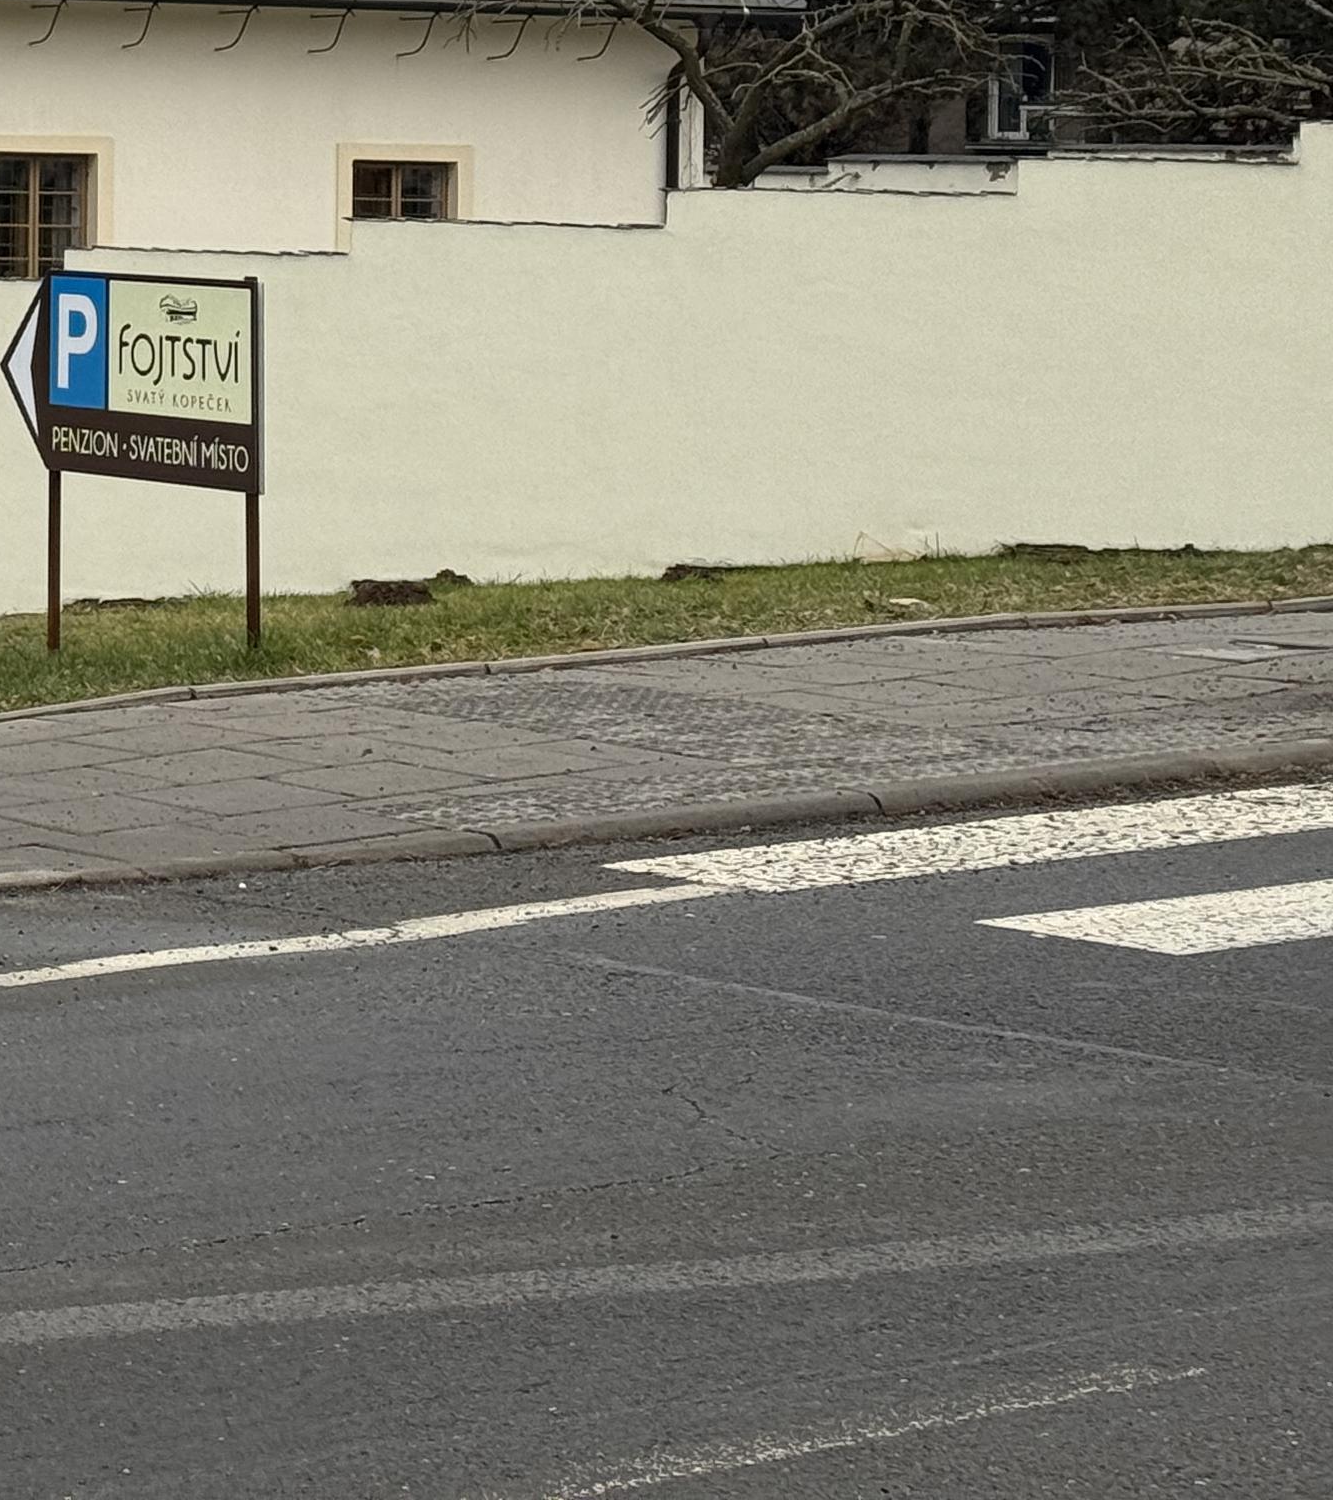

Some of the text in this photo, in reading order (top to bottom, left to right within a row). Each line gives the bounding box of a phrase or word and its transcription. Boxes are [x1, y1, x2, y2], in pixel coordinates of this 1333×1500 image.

[57, 293, 98, 390] P
[126, 388, 232, 413] SVATÝ KOPEČEK
[51, 426, 250, 473] PENZION SVATEBNÍ MÍSTO
